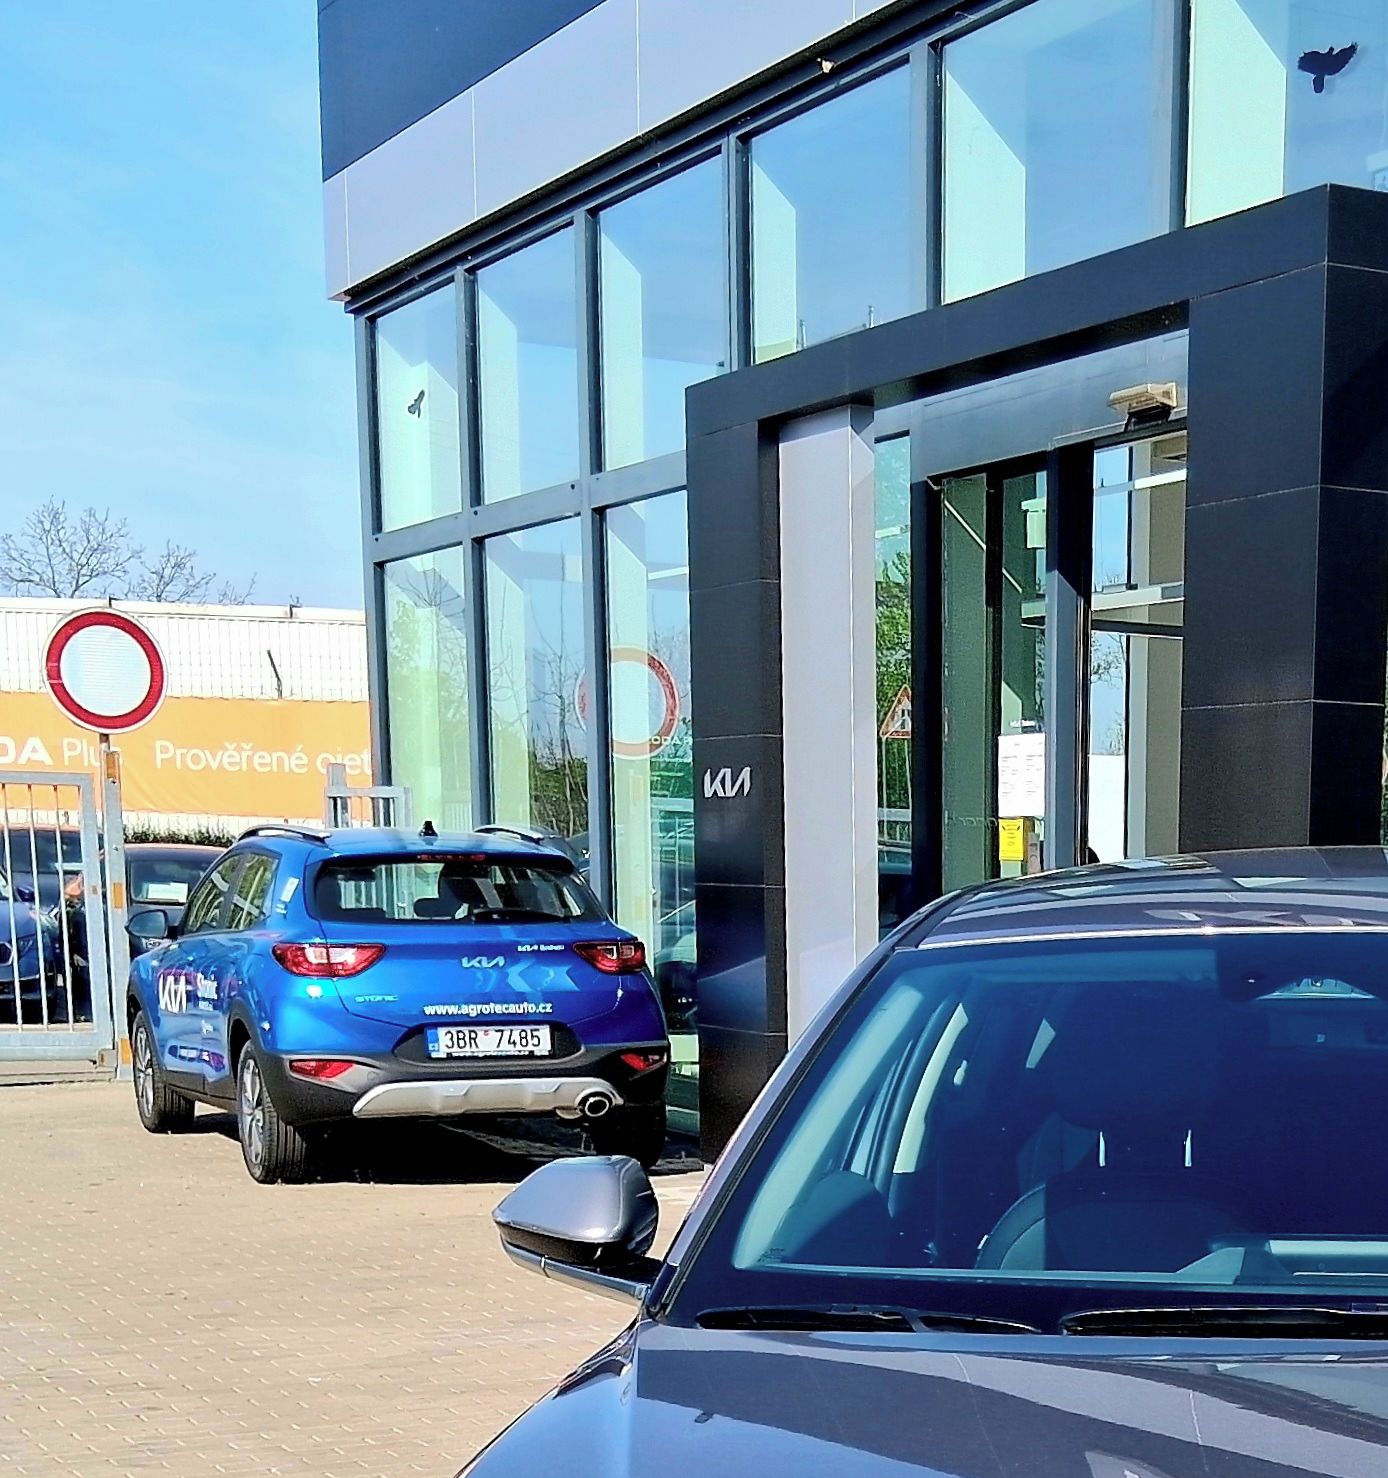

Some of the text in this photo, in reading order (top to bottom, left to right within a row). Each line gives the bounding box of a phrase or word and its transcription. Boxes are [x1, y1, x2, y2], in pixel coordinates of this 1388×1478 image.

[63, 737, 123, 768] Plu
[155, 739, 309, 774] Prověřené
[704, 766, 751, 798] KIA
[462, 956, 505, 968] KIA
[423, 1002, 553, 1017] www.agrotecauto.cz
[444, 1028, 541, 1050] 3BR 7485
